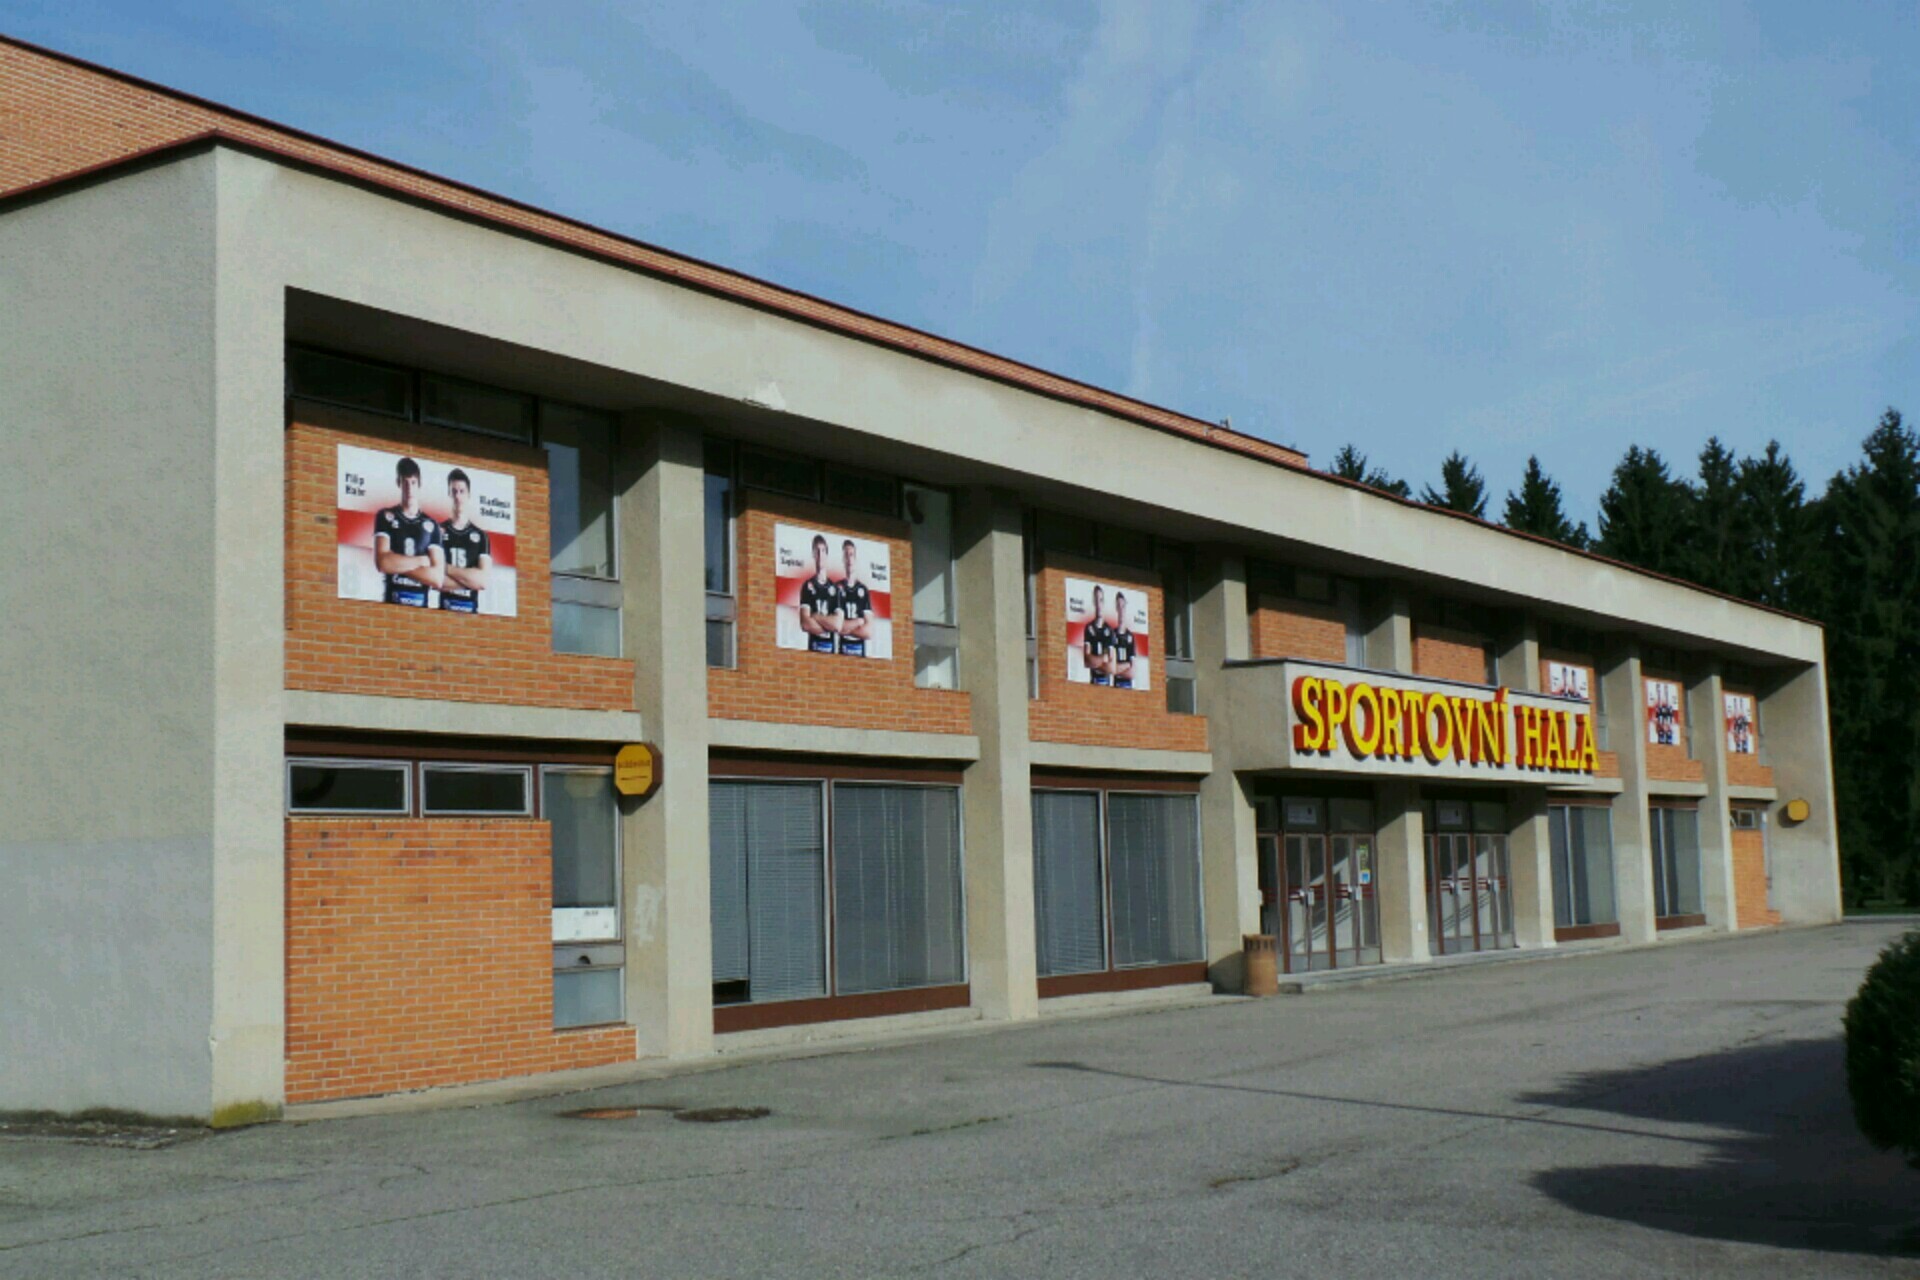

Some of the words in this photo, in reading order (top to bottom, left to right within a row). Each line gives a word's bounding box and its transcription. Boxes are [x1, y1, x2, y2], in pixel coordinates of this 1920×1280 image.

[449, 547, 467, 567] 15
[1291, 675, 1511, 766] SPORTOVNÍ
[1513, 704, 1601, 771] HALA
